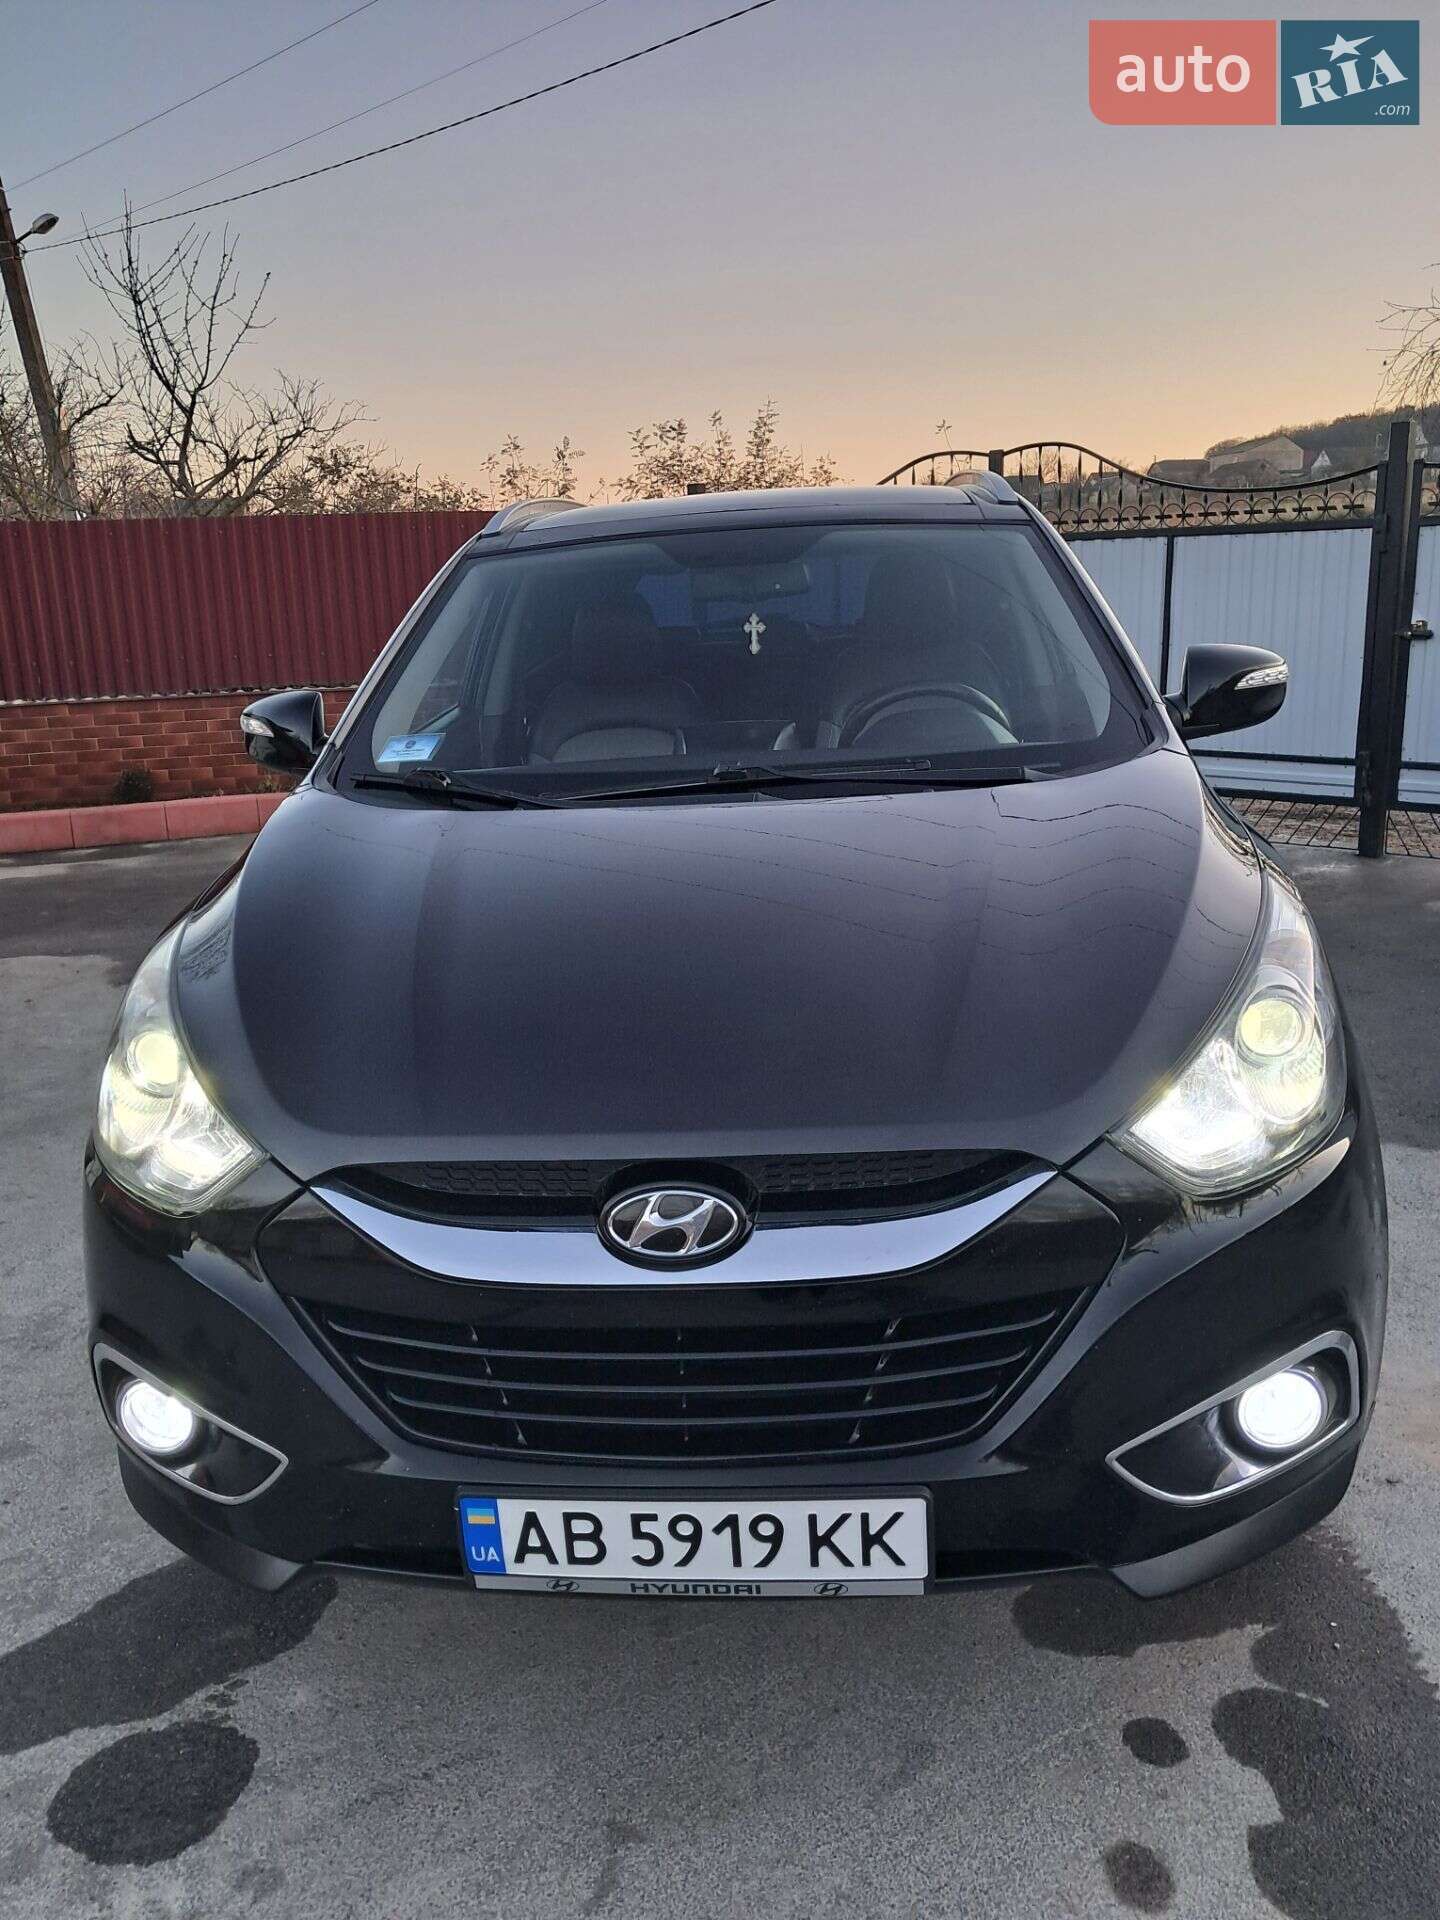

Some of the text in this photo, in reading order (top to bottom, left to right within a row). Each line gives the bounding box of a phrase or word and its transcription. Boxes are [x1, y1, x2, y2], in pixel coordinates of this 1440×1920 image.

[514, 1511, 906, 1568] AB 5919 KK
[471, 1545, 501, 1562] UA
[630, 1582, 762, 1596] HYUNDAI
